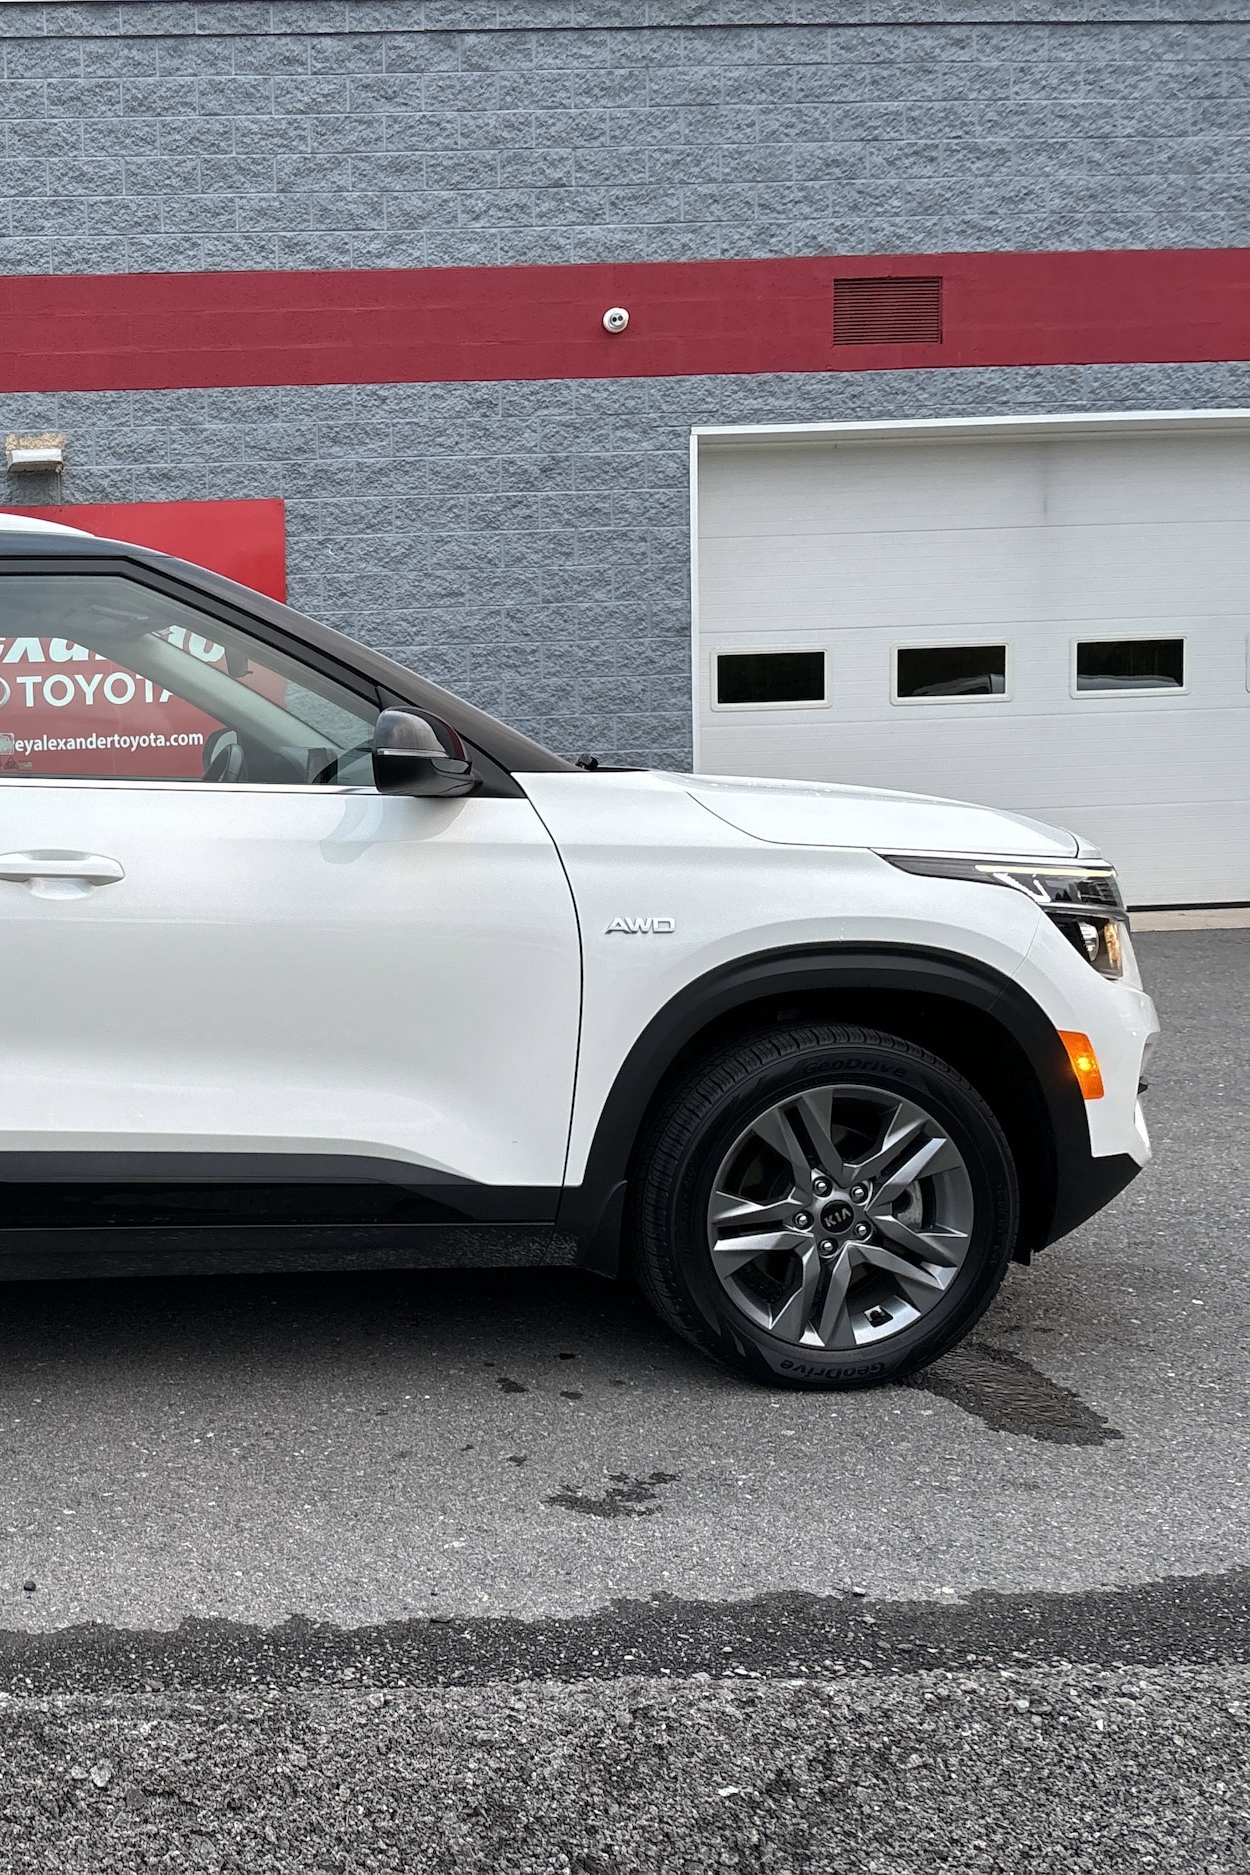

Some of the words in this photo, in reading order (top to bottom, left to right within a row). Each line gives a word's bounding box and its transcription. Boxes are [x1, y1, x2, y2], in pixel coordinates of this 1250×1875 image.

[16, 671, 174, 707] TOYOT
[605, 917, 676, 934] AWD
[802, 1056, 907, 1078] GeoDrive
[824, 1207, 852, 1228] KIA
[779, 1358, 886, 1380] GeoDrive
